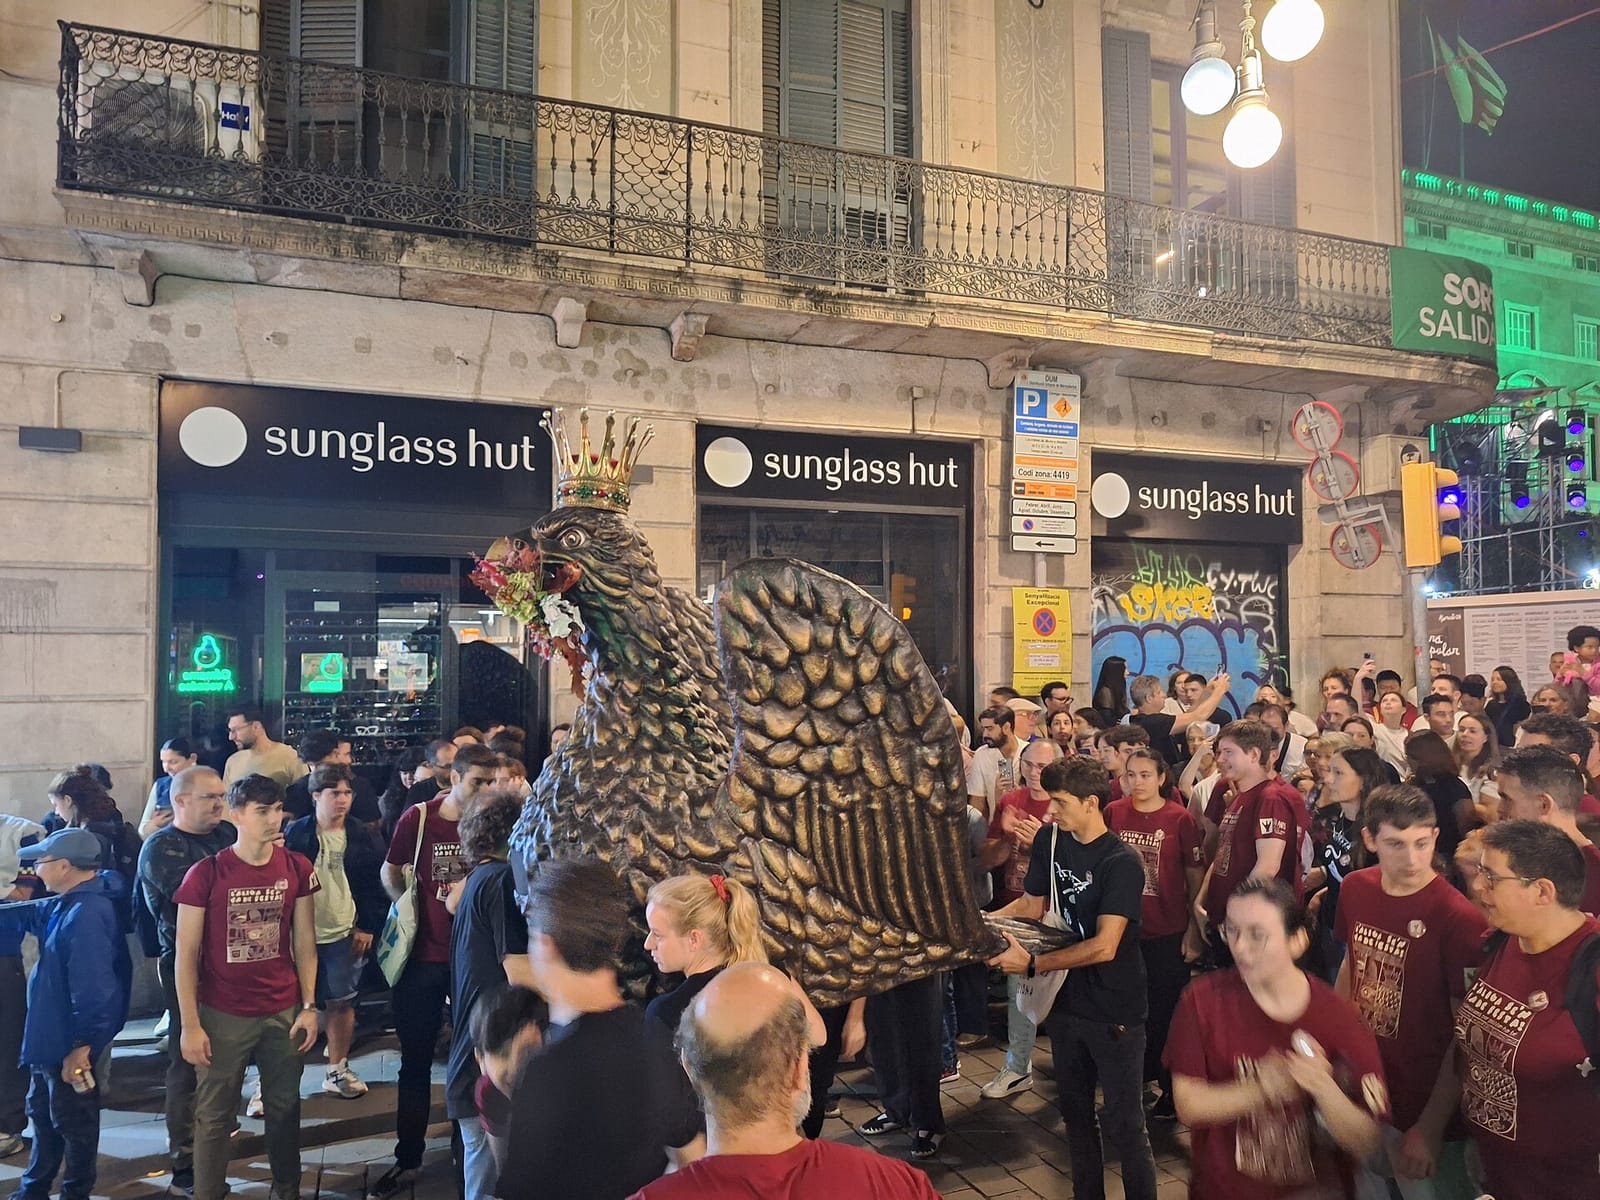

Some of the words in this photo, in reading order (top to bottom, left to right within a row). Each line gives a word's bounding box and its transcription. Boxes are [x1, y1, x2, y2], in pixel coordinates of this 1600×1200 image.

[222, 111, 249, 123] Har
[1443, 272, 1494, 315] SOR
[1023, 389, 1041, 415] P
[264, 421, 457, 472] sunglass
[468, 428, 536, 472] hut
[764, 447, 901, 491] sunglass
[909, 452, 959, 488] hut
[1018, 468, 1033, 477] Codi
[1053, 470, 1070, 480] 4419
[1138, 480, 1250, 520] sunglass
[1255, 484, 1296, 516] hut
